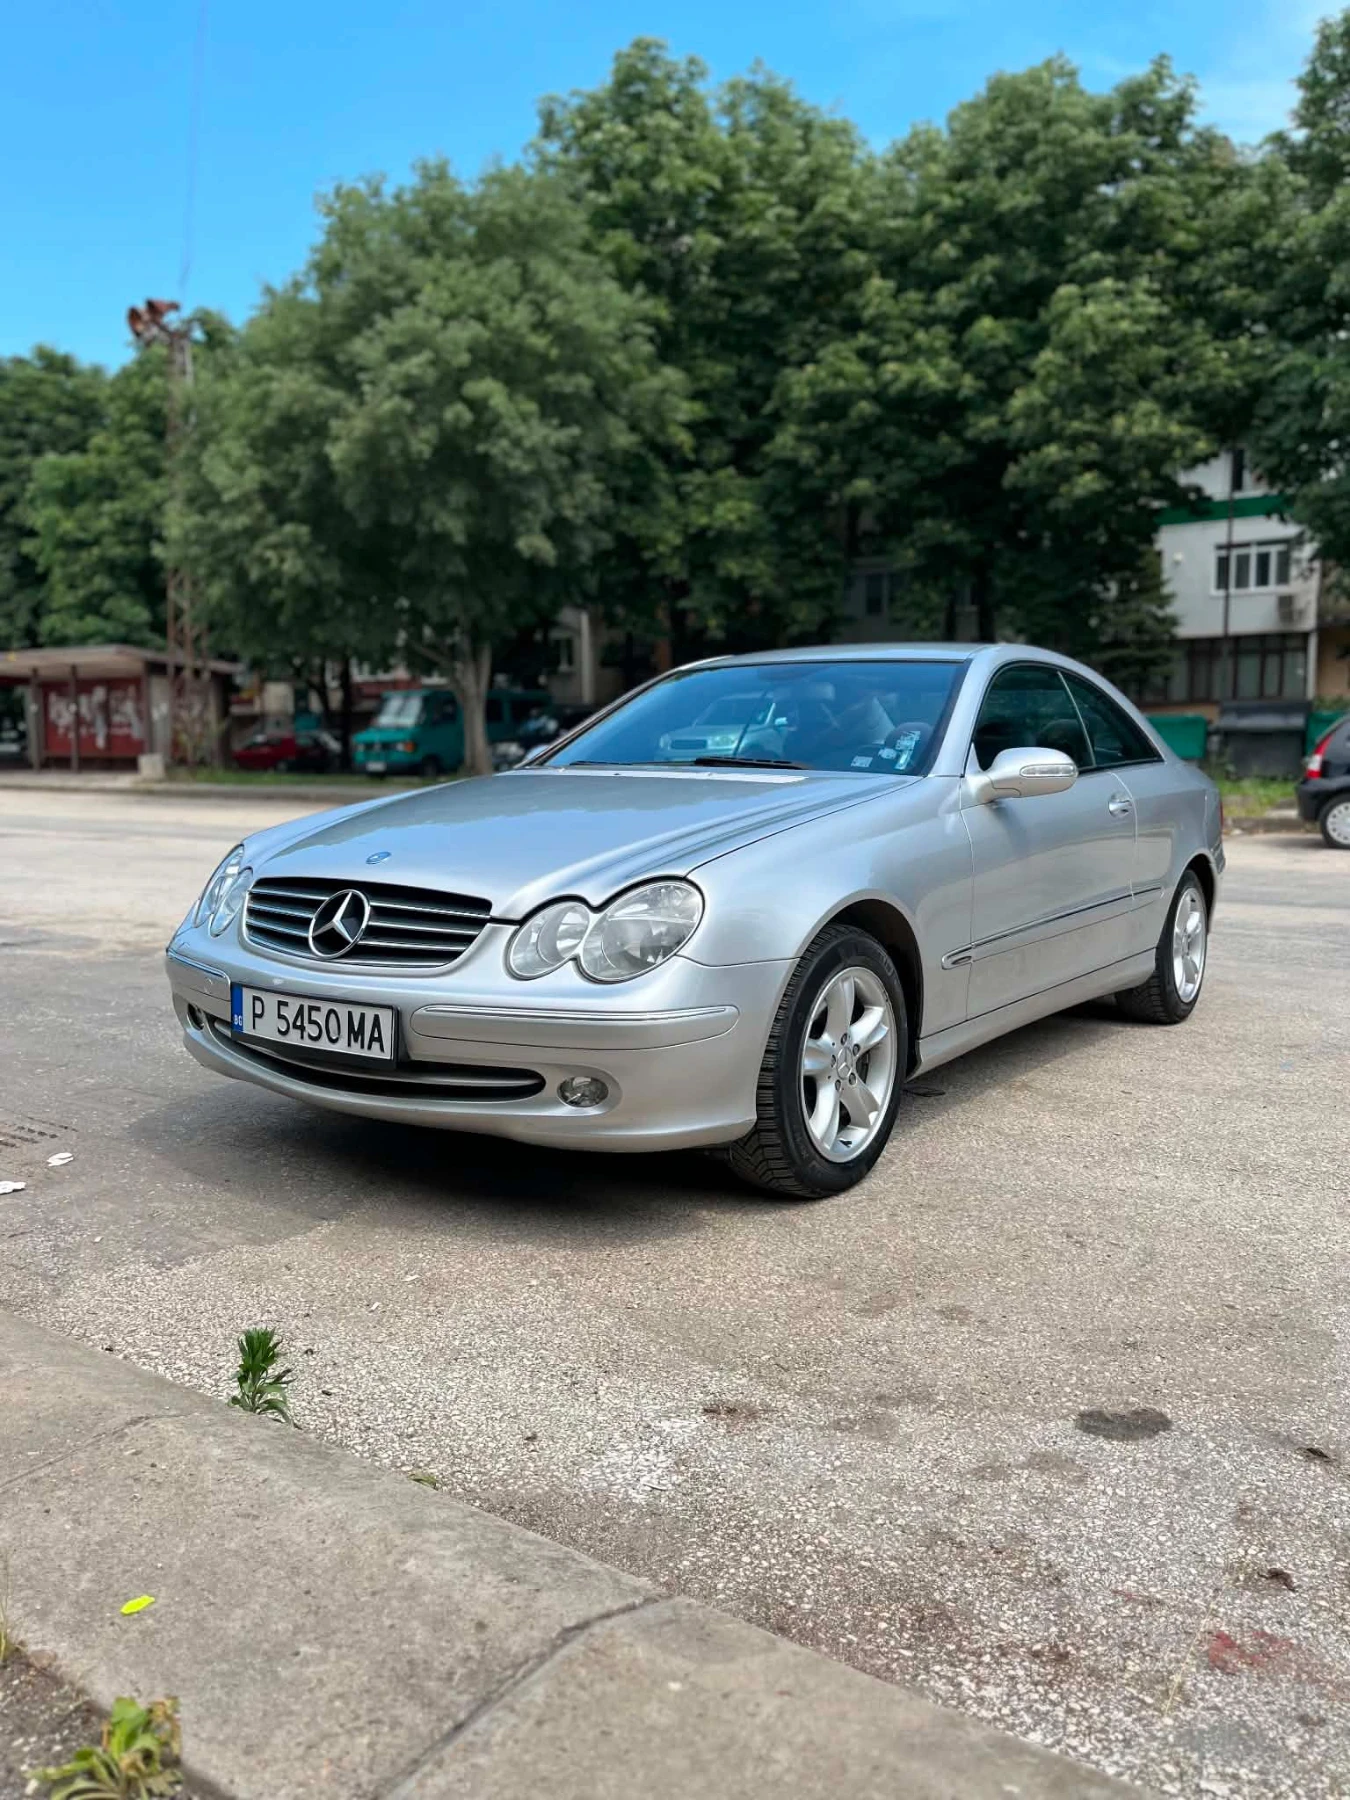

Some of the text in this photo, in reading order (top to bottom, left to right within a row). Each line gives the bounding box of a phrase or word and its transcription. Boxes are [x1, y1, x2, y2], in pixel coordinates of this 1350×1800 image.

[234, 1014, 242, 1026] BG
[252, 995, 385, 1053] P 5450 MA
